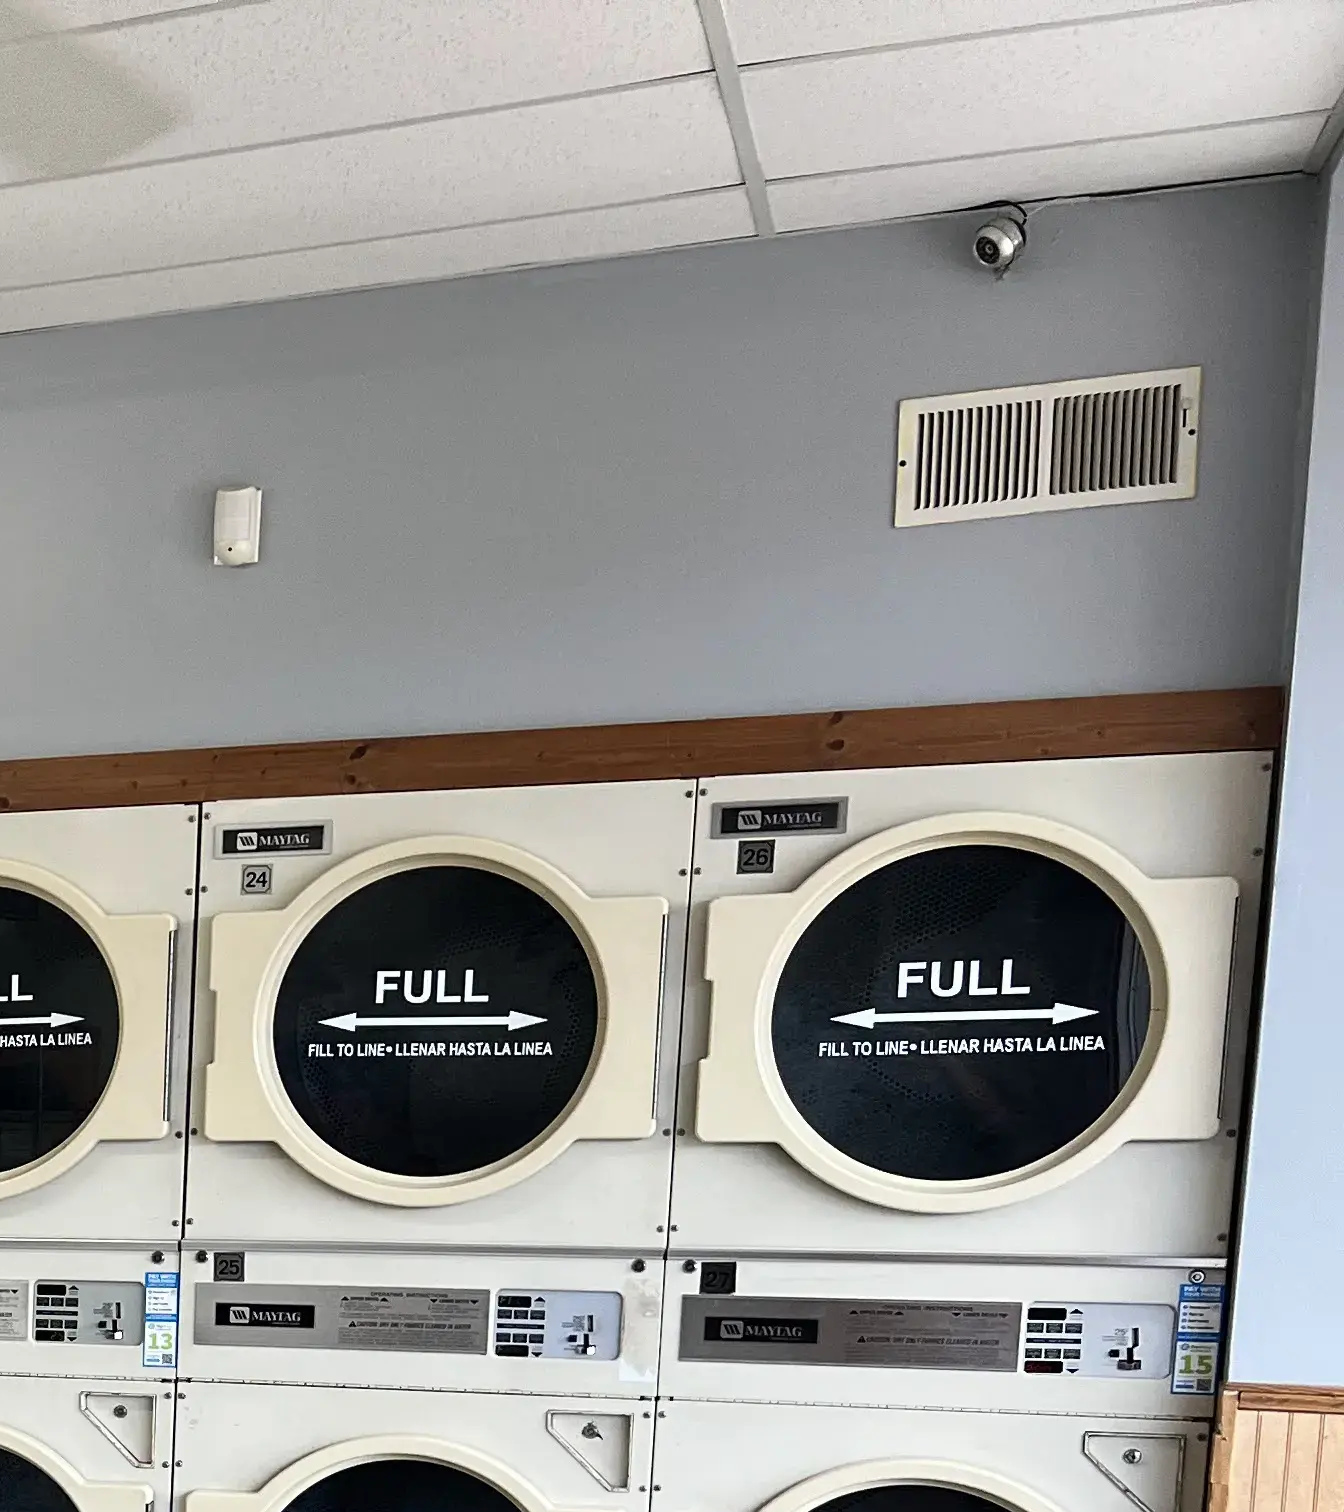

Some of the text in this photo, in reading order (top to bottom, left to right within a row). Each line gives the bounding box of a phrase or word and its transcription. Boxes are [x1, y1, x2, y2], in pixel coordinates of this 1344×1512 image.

[763, 812, 822, 827] MAYTAG
[258, 833, 310, 848] MAYTAG
[743, 848, 770, 867] 26
[245, 871, 269, 888] 24
[376, 970, 489, 1003] FULL
[898, 959, 1030, 997] FULL
[0, 1035, 37, 1047] HASTA
[39, 1034, 55, 1045] LA
[57, 1033, 92, 1045] LINEA
[818, 1042, 849, 1056] FILL
[852, 1042, 872, 1055] TO
[983, 1038, 1033, 1052] HASTA
[1036, 1037, 1056, 1051] LA
[1059, 1036, 1105, 1051] LINEA
[307, 1044, 334, 1057] FILL
[336, 1044, 354, 1056] TO
[448, 1042, 491, 1055] HASTA
[493, 1043, 511, 1055] LA
[513, 1042, 552, 1055] LINEA
[218, 1258, 240, 1276] 25
[252, 1310, 301, 1324] MAYTAG
[744, 1324, 802, 1338] MAYTAG
[148, 1333, 173, 1350] 13
[1178, 1354, 1213, 1375] 15
